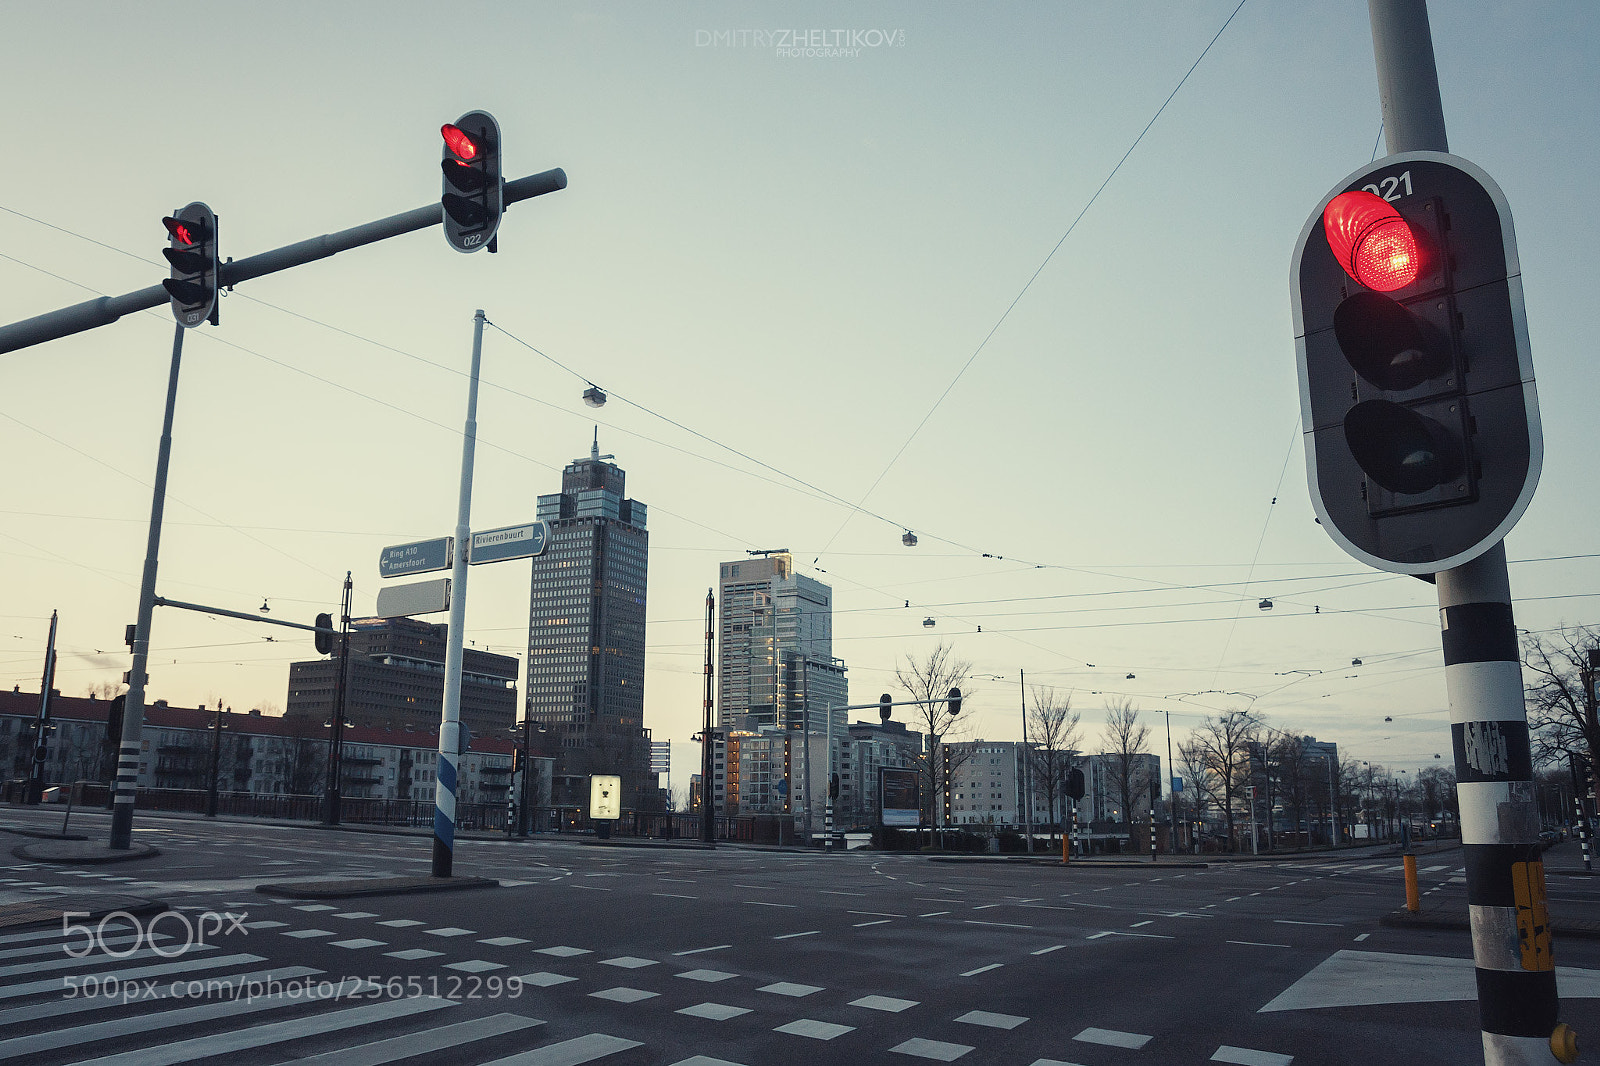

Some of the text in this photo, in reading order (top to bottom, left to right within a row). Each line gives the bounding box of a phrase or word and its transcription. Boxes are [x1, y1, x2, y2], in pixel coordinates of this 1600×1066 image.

[463, 233, 482, 247] 022
[475, 530, 524, 545] Rivierenbuurt
[389, 546, 418, 559] Ring A10
[388, 558, 426, 571] Amersfoort
